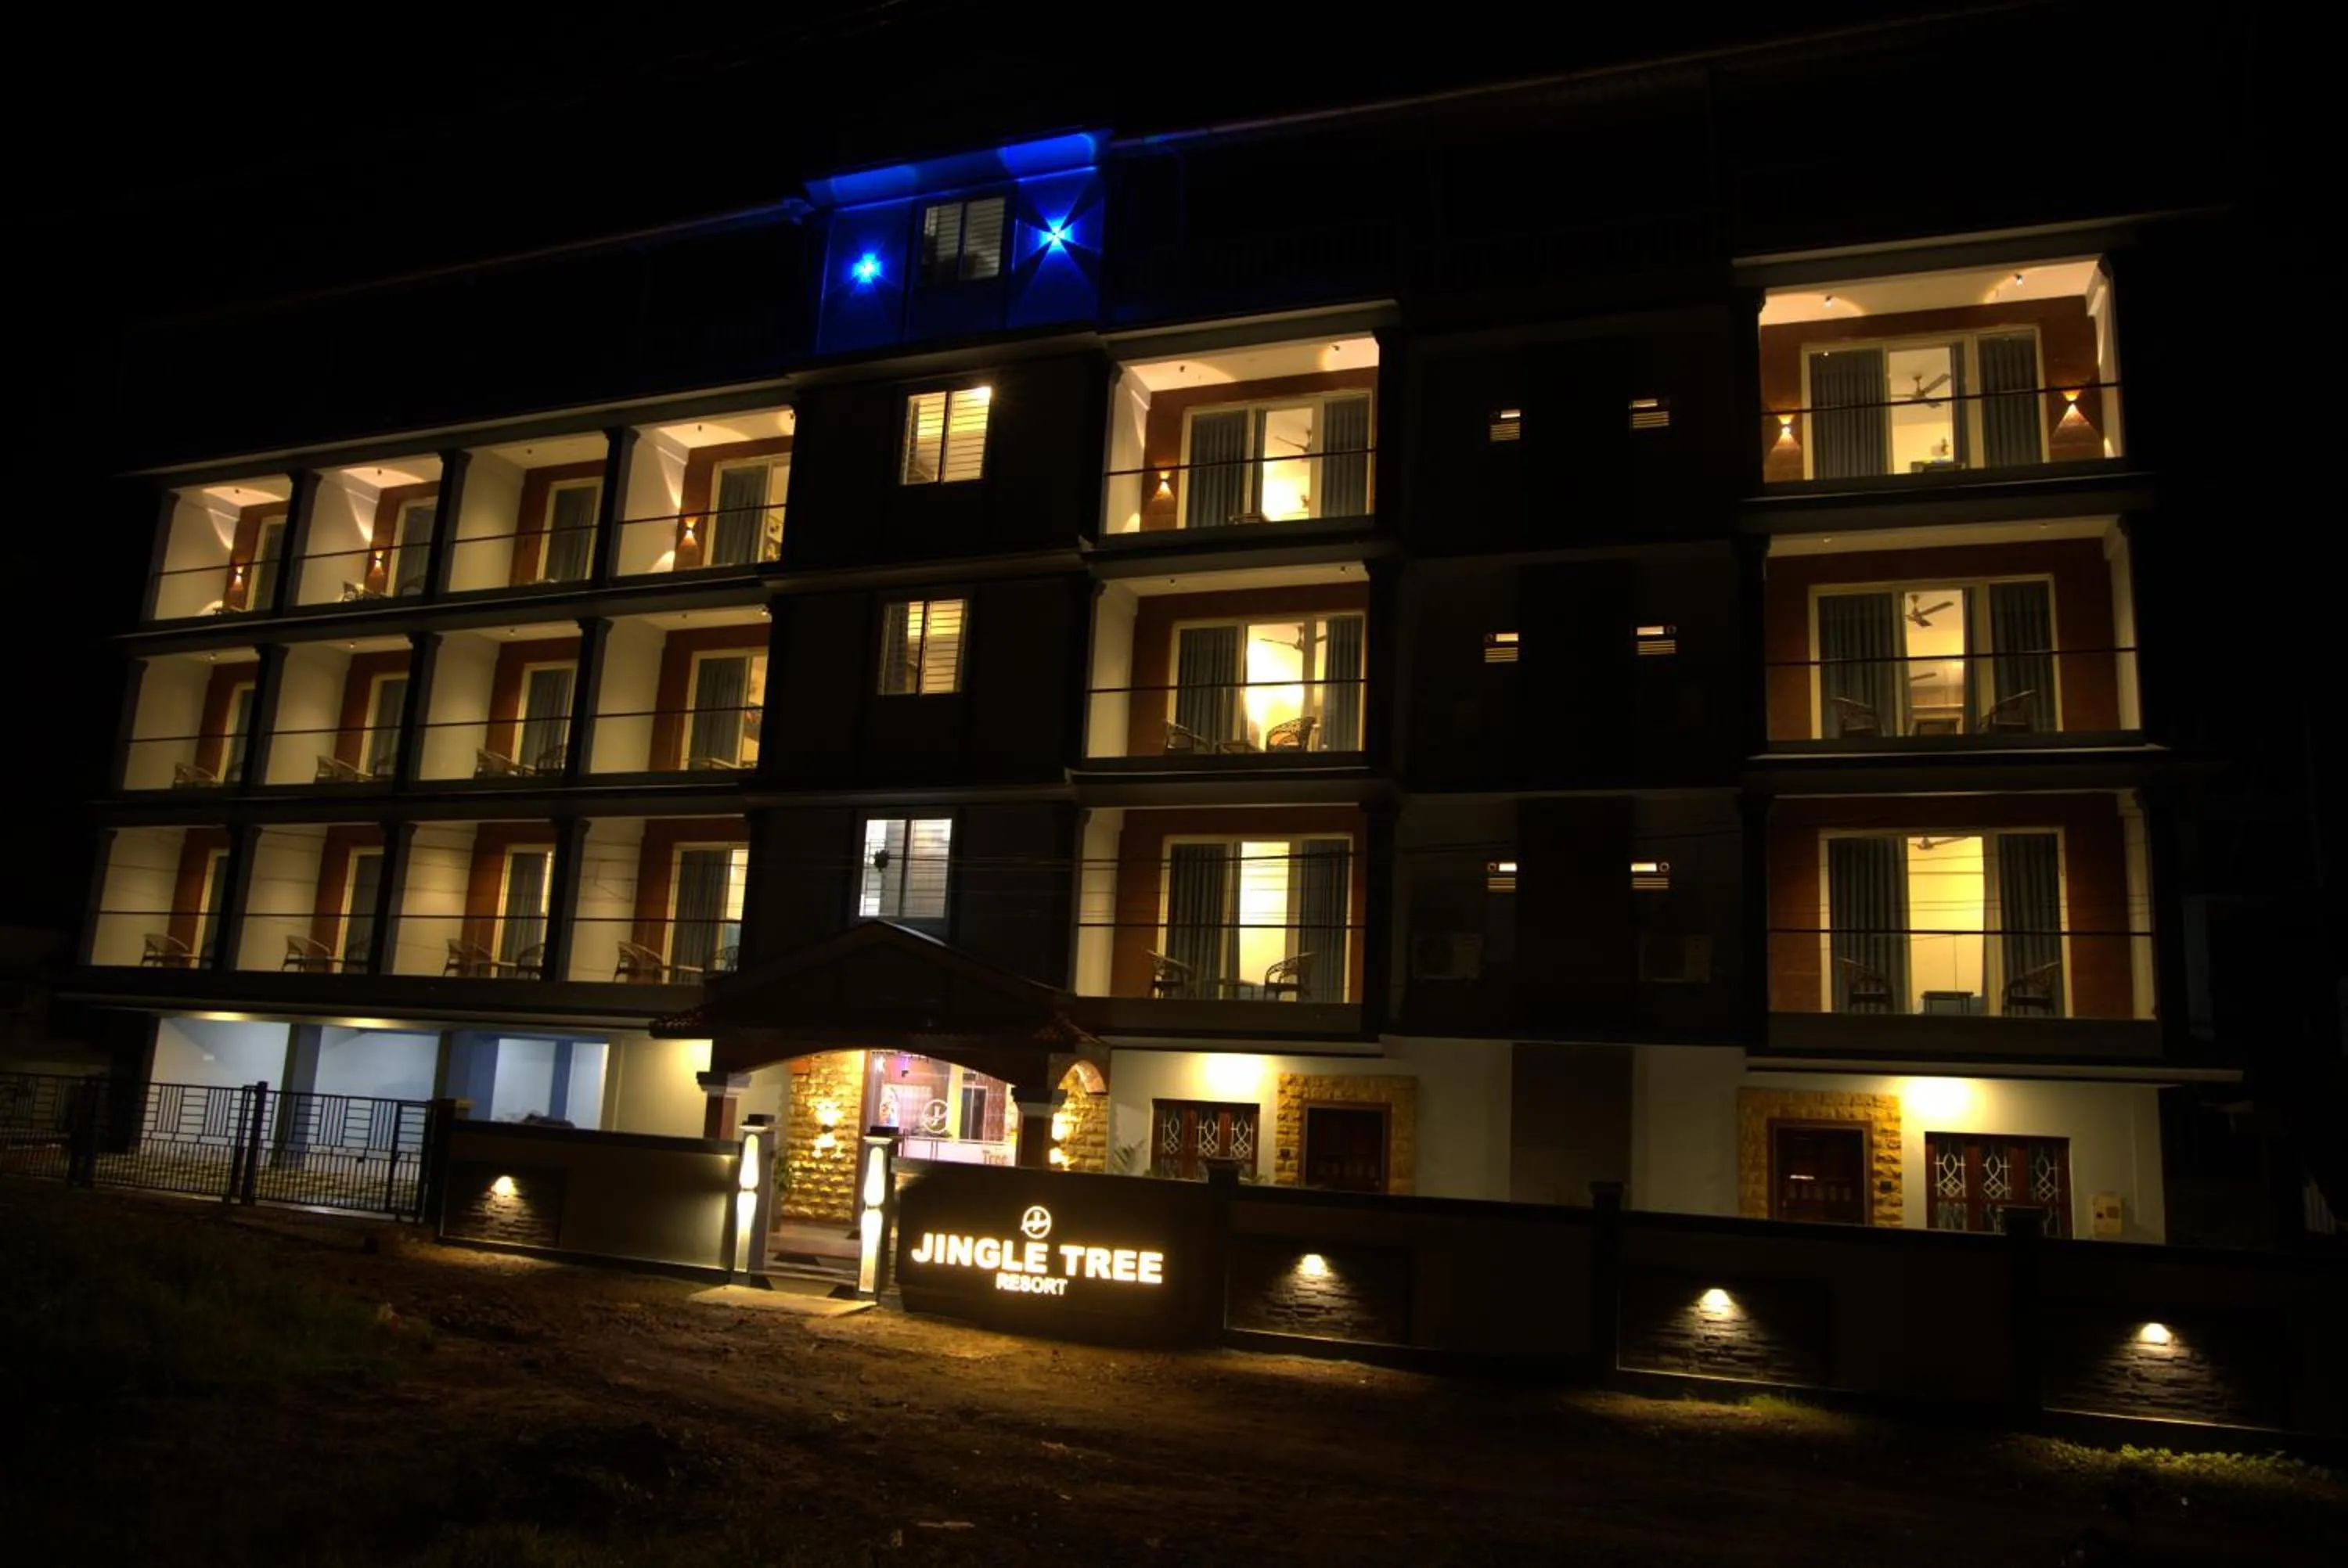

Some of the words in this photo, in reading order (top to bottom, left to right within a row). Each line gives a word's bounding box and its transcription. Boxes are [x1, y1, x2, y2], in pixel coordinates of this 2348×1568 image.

[911, 1232, 1049, 1274] JINGLE
[1059, 1243, 1164, 1284] TREE
[996, 1272, 1068, 1296] RESORT
